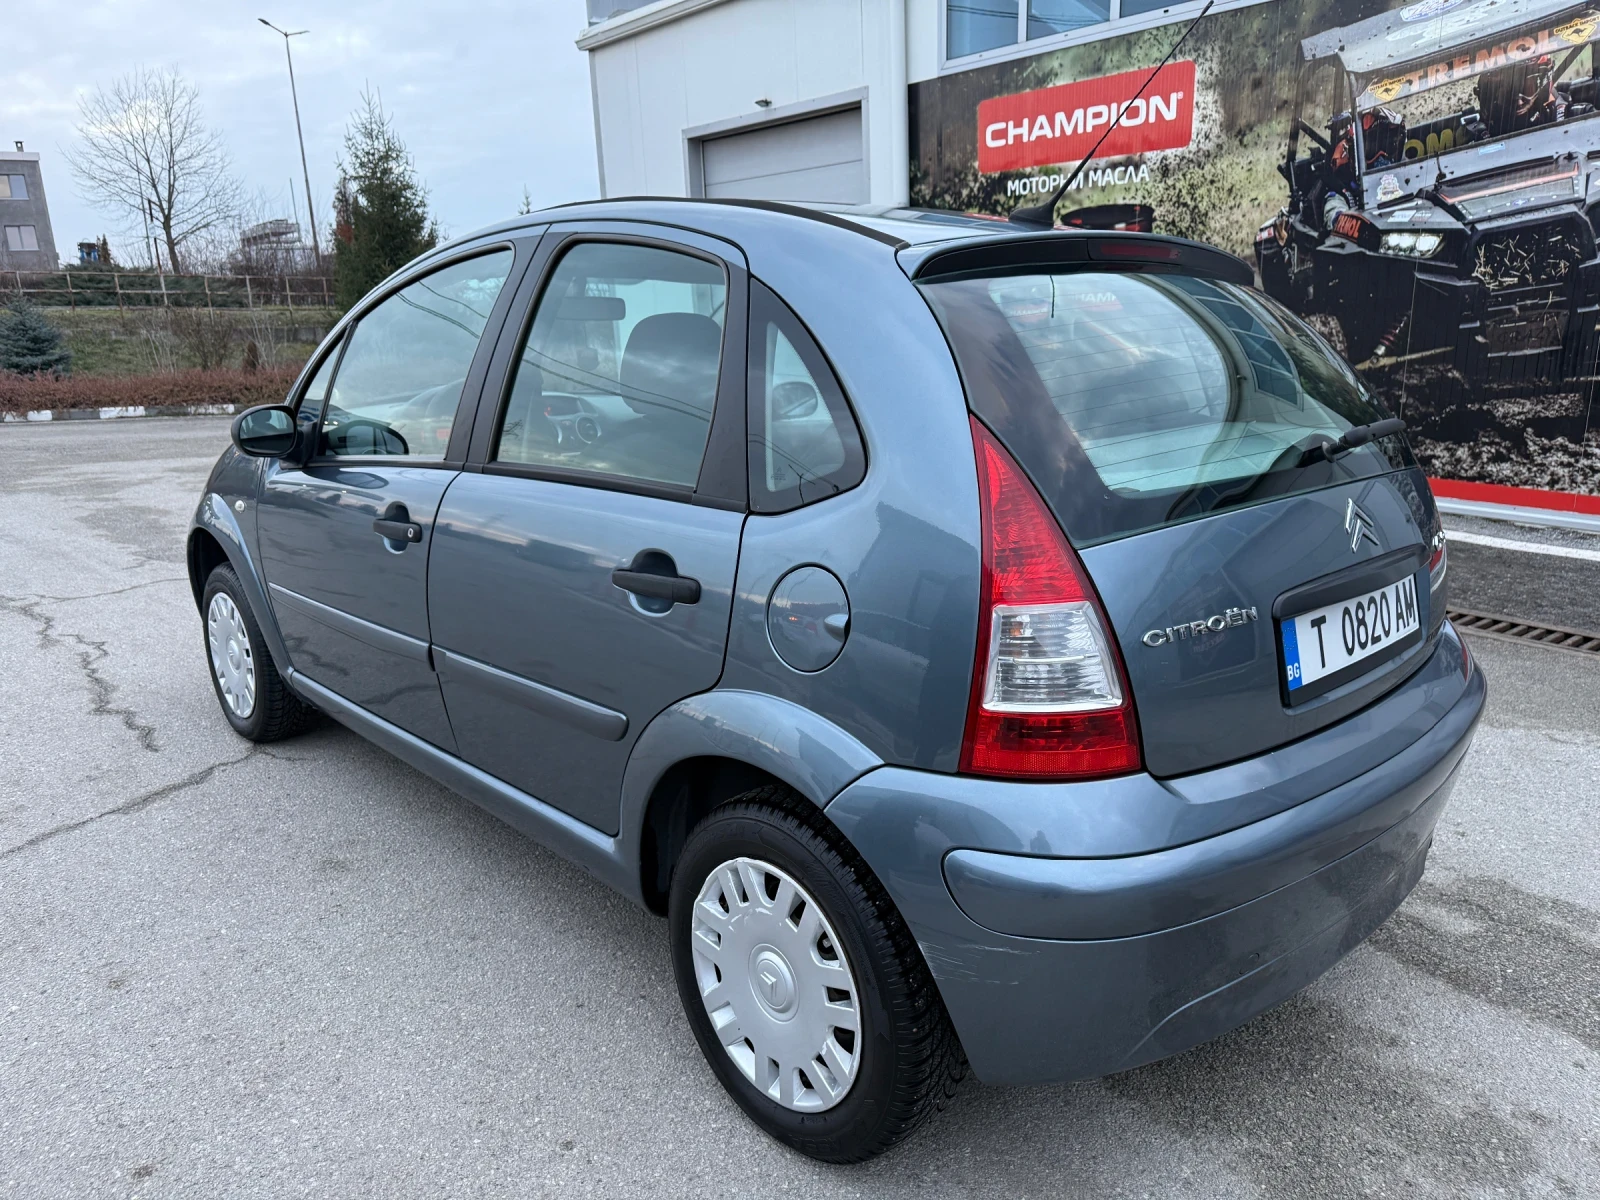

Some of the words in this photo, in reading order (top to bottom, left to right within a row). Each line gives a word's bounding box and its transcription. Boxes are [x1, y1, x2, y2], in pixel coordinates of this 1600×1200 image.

[985, 92, 1178, 148] CHAMPION
[1007, 173, 1084, 197] МОТОРНИ
[1088, 165, 1150, 187] МАСЛА
[1142, 607, 1259, 647] CITROËN
[1310, 615, 1327, 669] T
[1341, 591, 1390, 656] 0820
[1395, 577, 1417, 635] AM
[1286, 661, 1300, 682] BG
